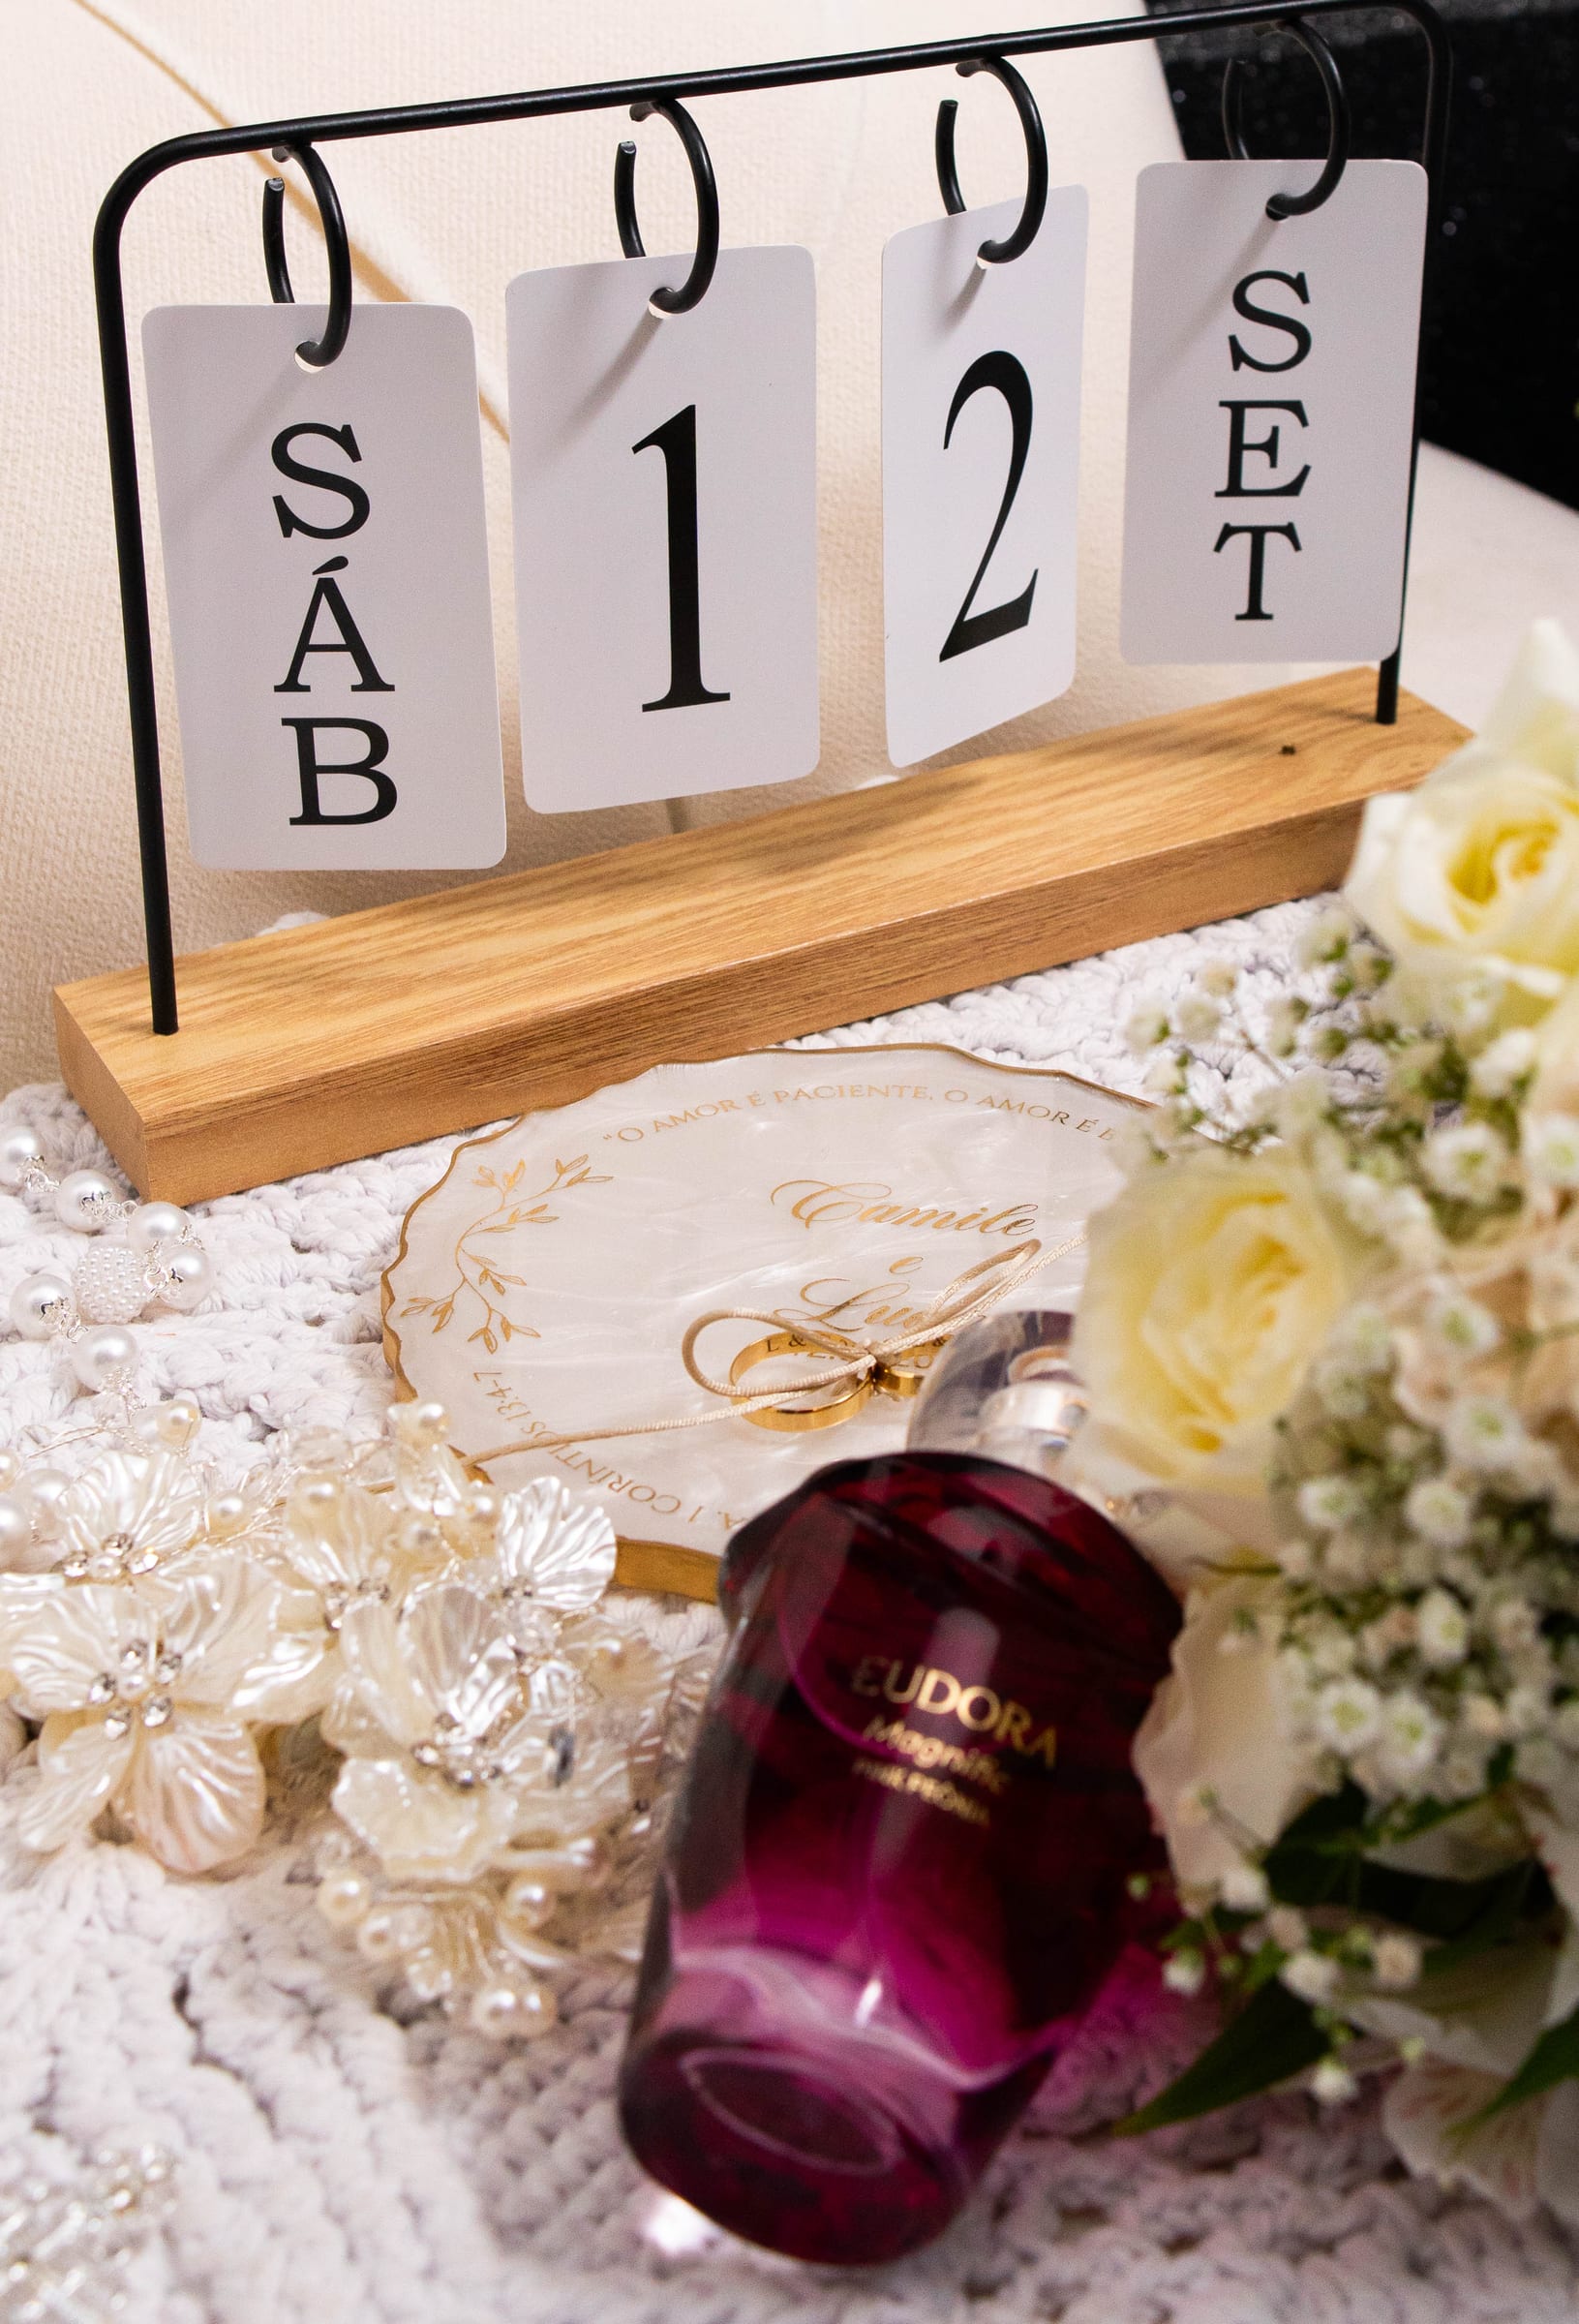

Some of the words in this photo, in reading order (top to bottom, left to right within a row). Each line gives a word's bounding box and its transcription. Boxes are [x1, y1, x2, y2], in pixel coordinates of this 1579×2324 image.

[631, 404, 731, 713] 1
[939, 350, 1039, 662] 2
[1213, 270, 1313, 622] SET
[270, 422, 398, 826] SÁB
[653, 1098, 742, 1133] AMOR
[746, 1090, 766, 1108] É
[943, 1088, 969, 1103] O
[976, 1094, 1071, 1126] AMOR
[1076, 1118, 1100, 1133] É
[770, 1178, 1039, 1237] Camile
[851, 1655, 1057, 1770] EUDORA
